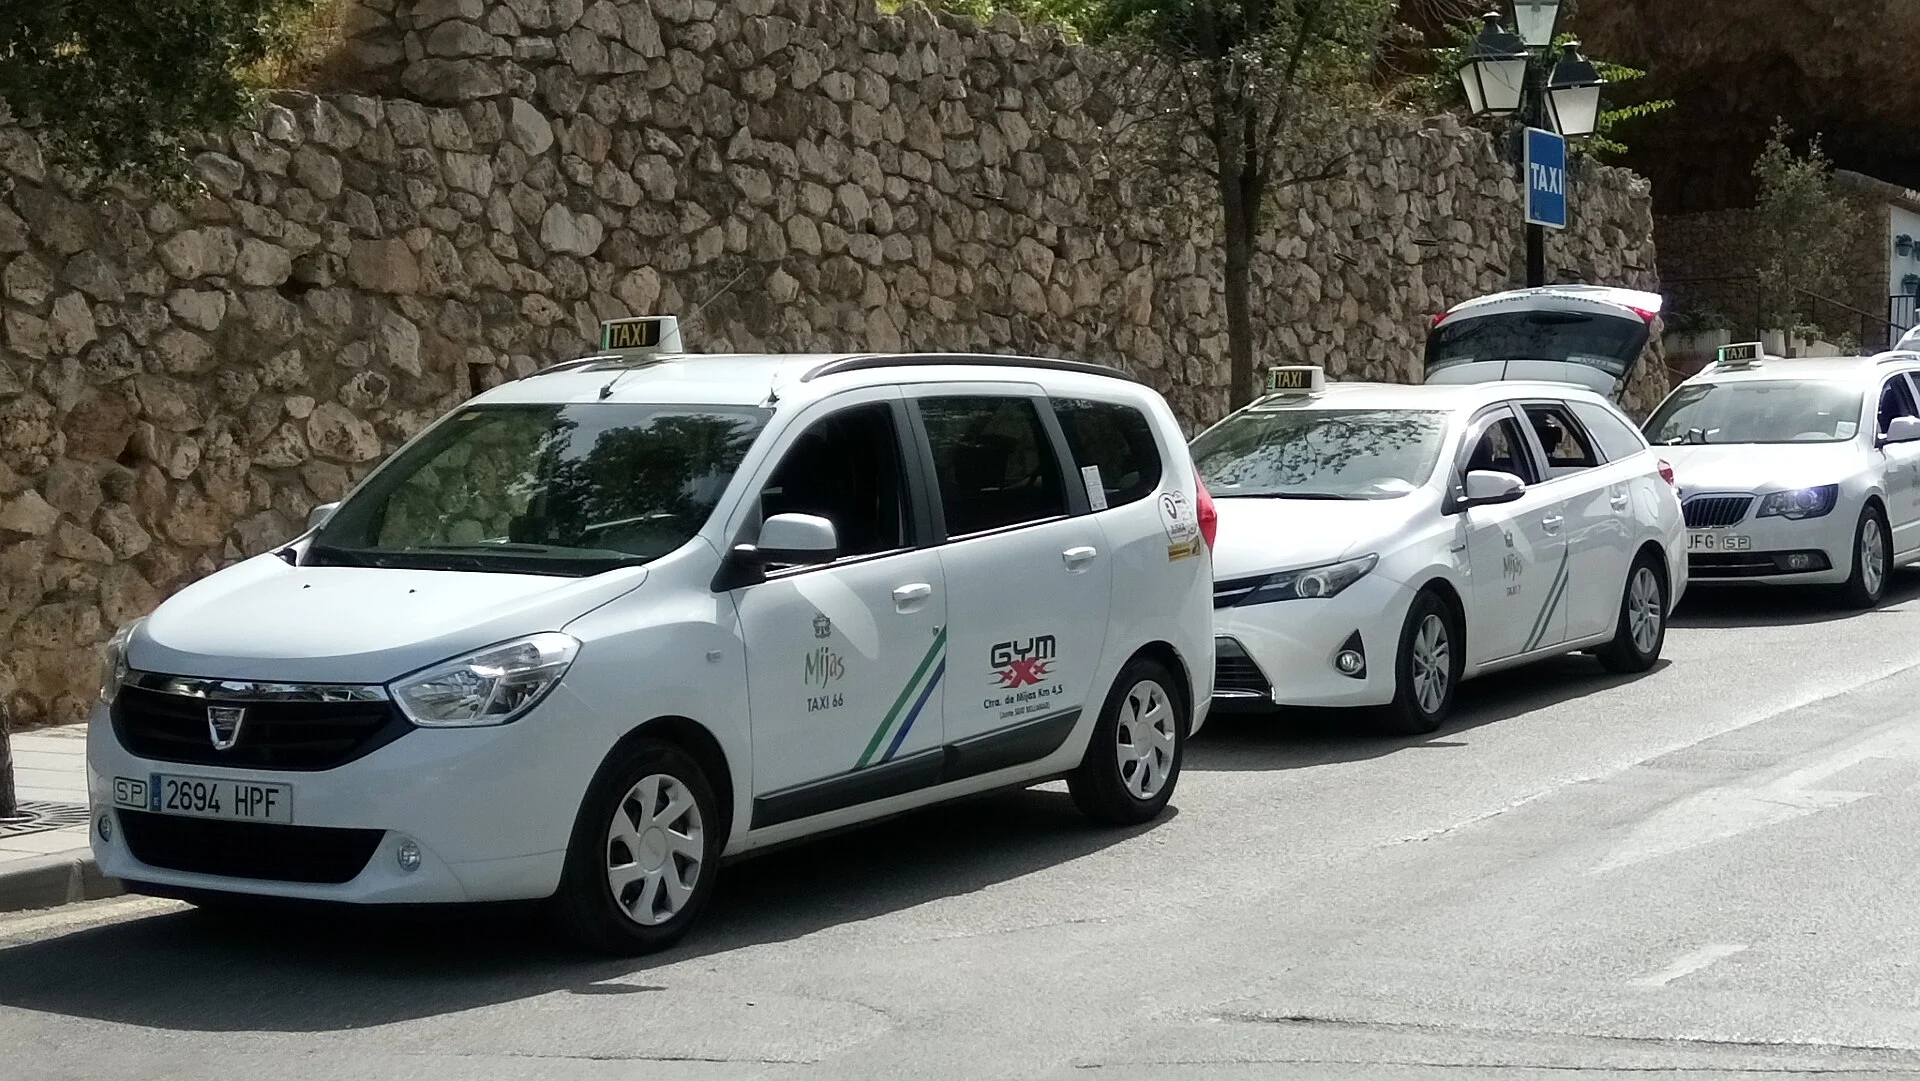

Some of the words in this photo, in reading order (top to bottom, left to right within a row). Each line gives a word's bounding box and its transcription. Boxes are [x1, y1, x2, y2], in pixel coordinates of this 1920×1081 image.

[1531, 162, 1562, 195] TAXI
[611, 323, 647, 347] TAXI
[1725, 347, 1747, 359] TAXI
[1276, 372, 1302, 387] TAXI
[1726, 538, 1748, 548] SP
[991, 635, 1055, 668] GYM
[805, 646, 845, 689] Mijas
[807, 695, 829, 712] TAXI
[832, 692, 844, 708] 66
[1005, 694, 1014, 704] de
[1016, 691, 1036, 703] Mijas
[1038, 688, 1050, 697] Km
[117, 781, 143, 803] SP
[166, 779, 221, 813] 2694
[235, 785, 279, 818] HPF
